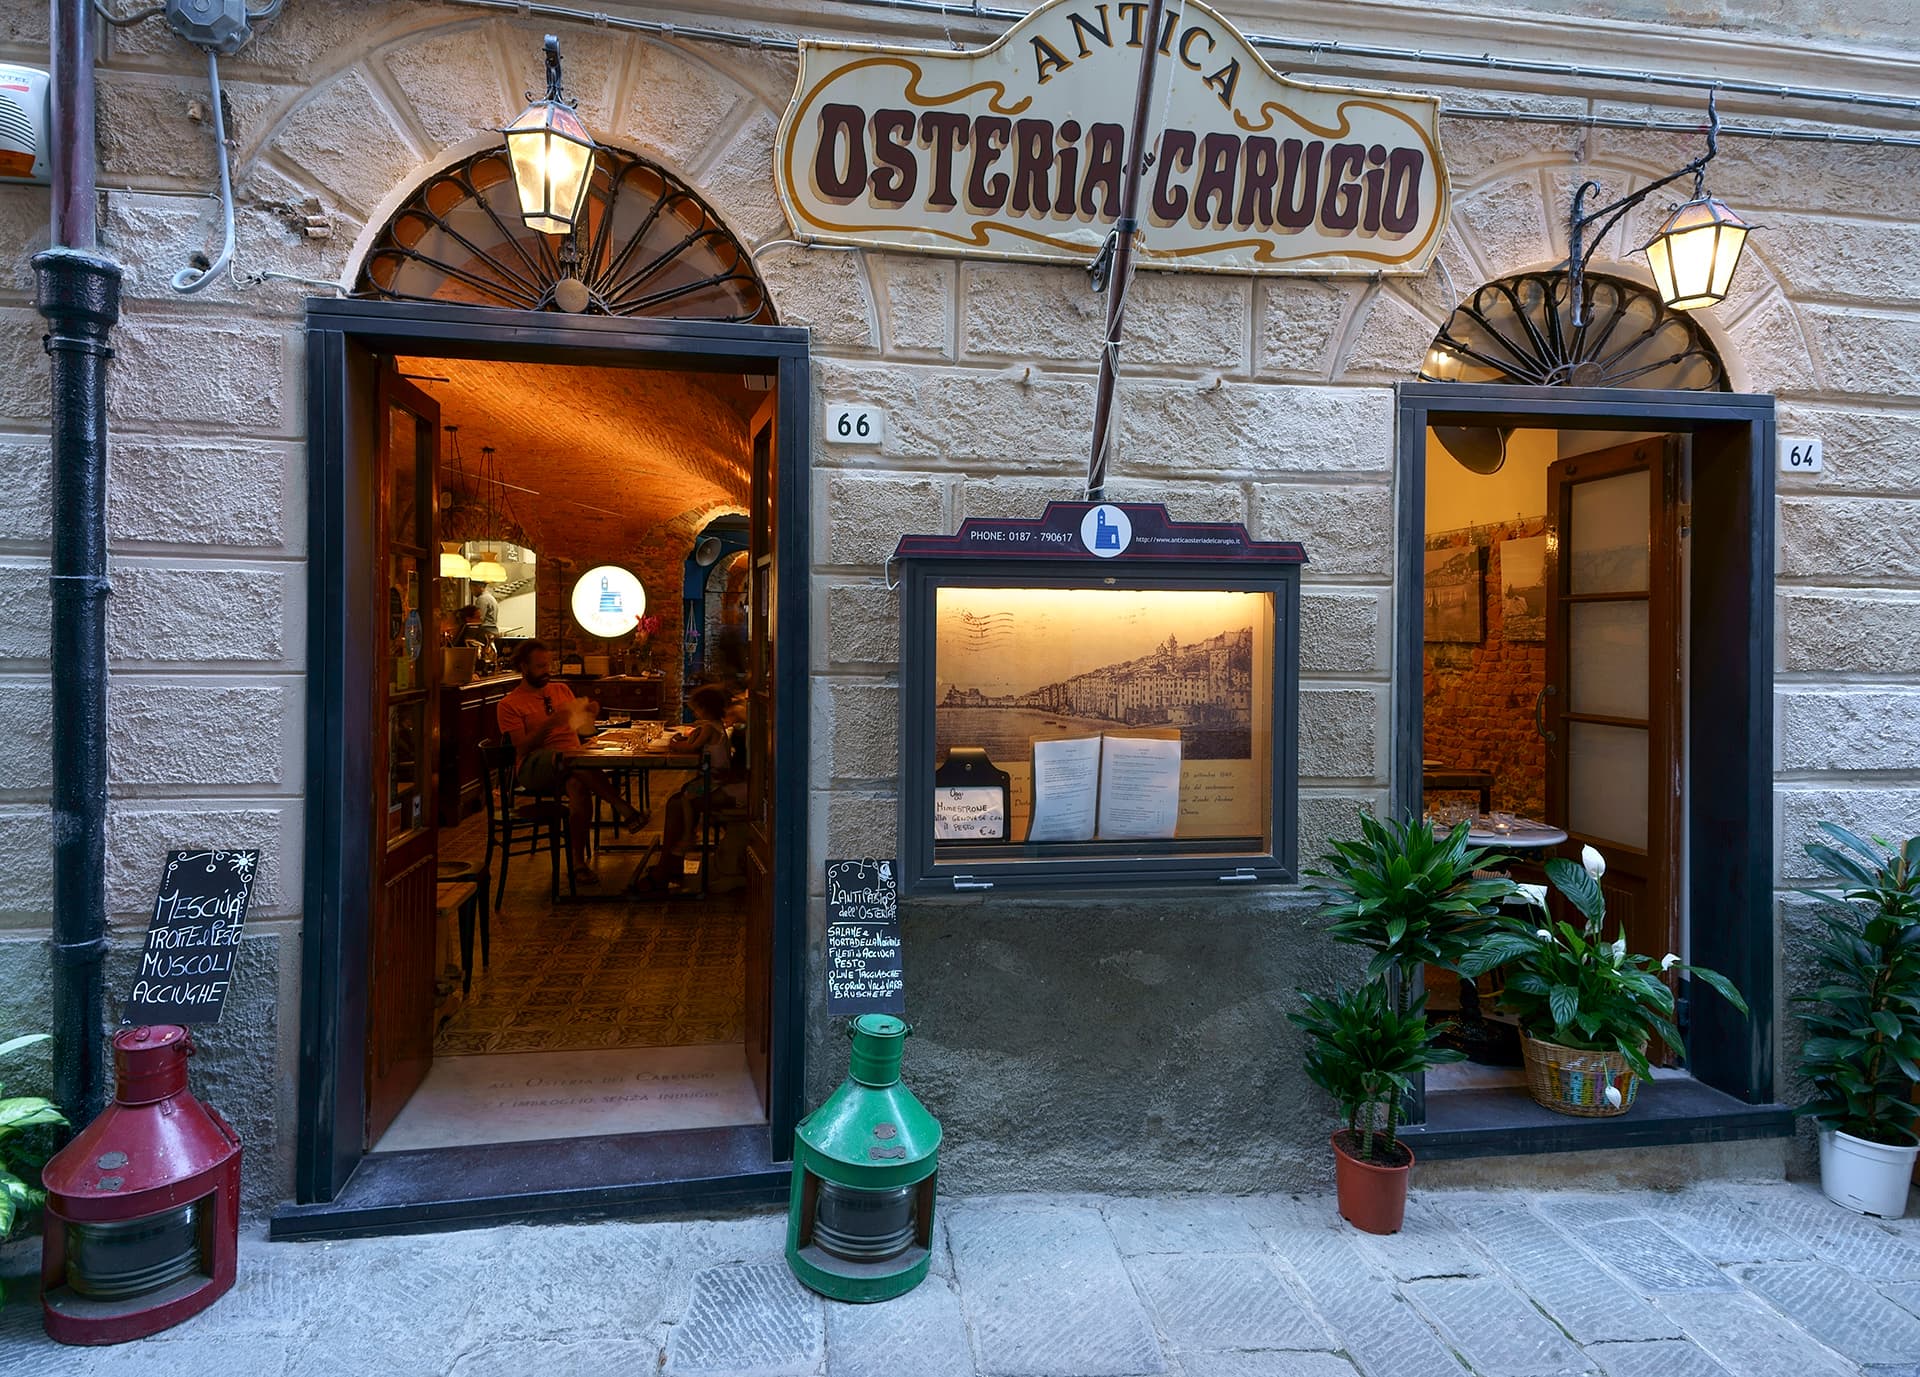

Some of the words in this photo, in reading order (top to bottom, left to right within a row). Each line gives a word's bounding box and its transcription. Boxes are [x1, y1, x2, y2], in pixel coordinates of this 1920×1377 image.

[1029, 2, 1241, 111] ANTICA
[837, 412, 870, 437] 66
[1790, 445, 1813, 467] 64
[970, 530, 1006, 541] PHONE:
[1008, 532, 1031, 542] 0187
[1040, 532, 1073, 543] 790617
[141, 951, 233, 978] MUSCOLI
[834, 958, 866, 969] PESTO
[133, 980, 229, 1004] ACCIUGHE
